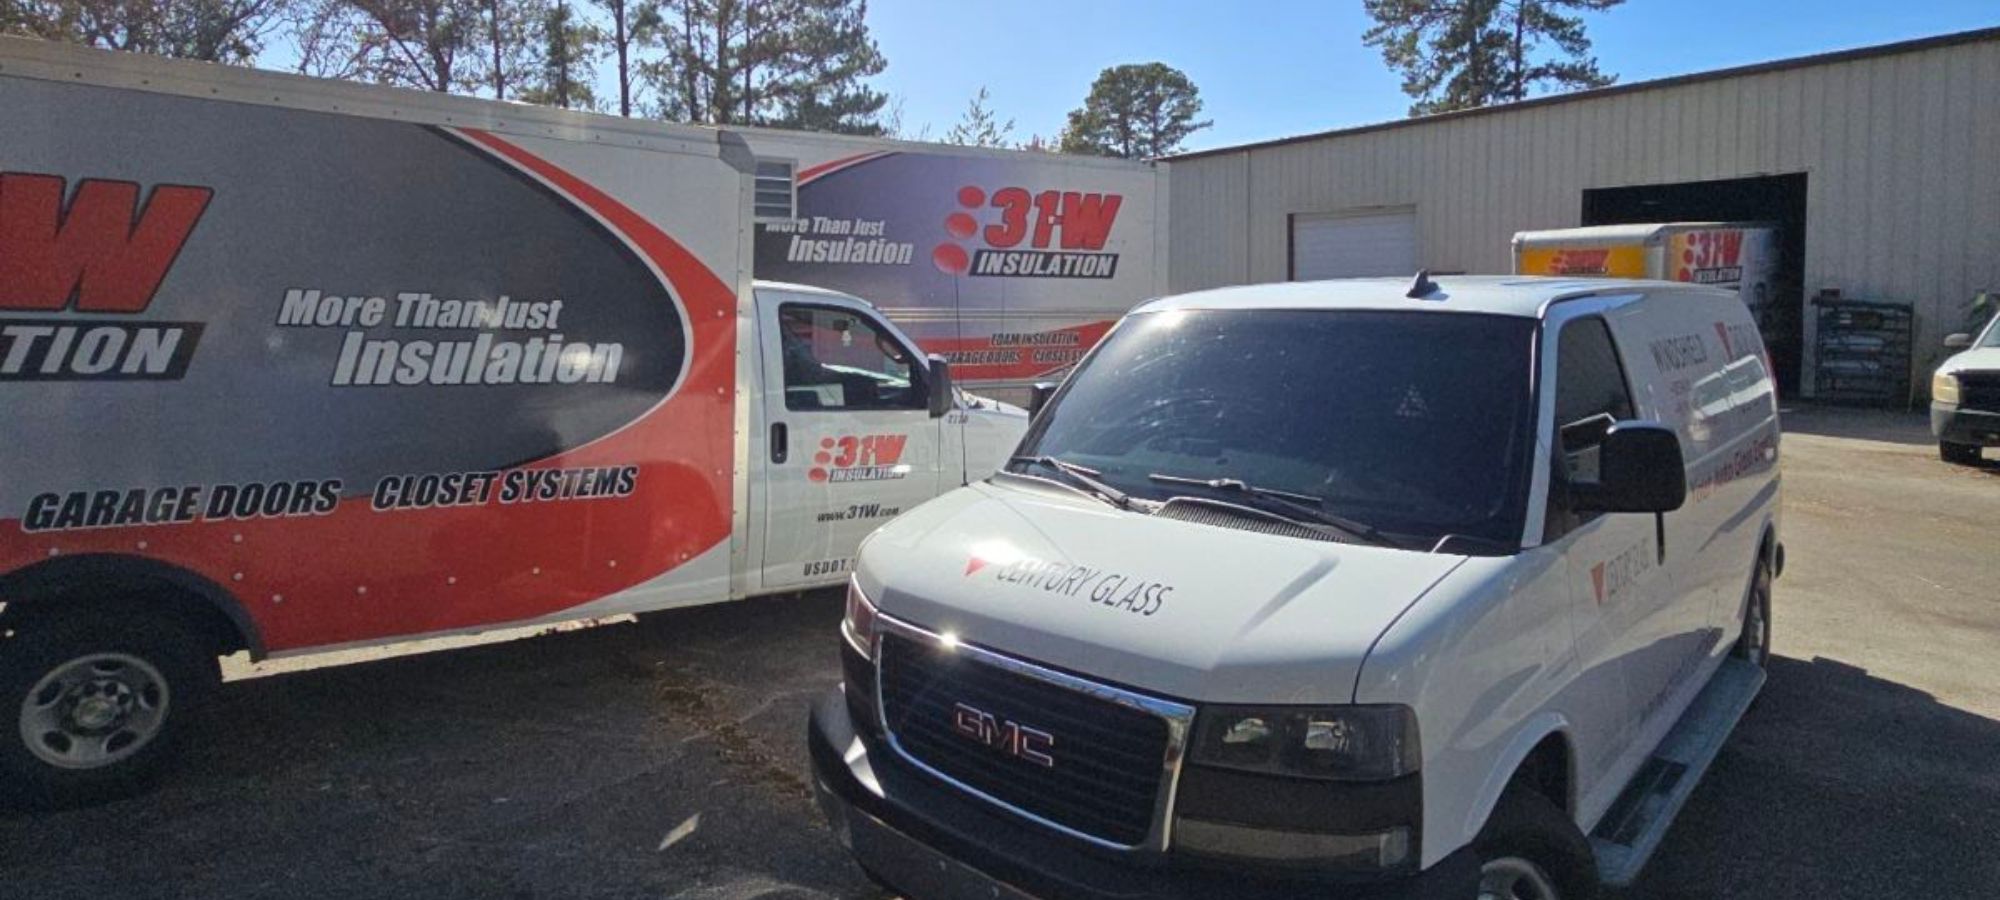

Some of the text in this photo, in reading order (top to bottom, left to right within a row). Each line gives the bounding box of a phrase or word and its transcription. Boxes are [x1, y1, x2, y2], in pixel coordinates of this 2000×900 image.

[813, 217, 850, 235] Than
[854, 218, 885, 236] Just
[787, 235, 914, 265] Insulation
[977, 252, 1113, 276] INSULATION
[276, 289, 564, 329] More Than Just
[332, 331, 624, 385] Insulation
[991, 332, 1079, 346] FOAM INSULATION
[22, 465, 639, 533] GARAGE DOORS CLOSET SYSTEMS
[1089, 574, 1173, 616] GLASS
[954, 702, 1055, 767] GMC
